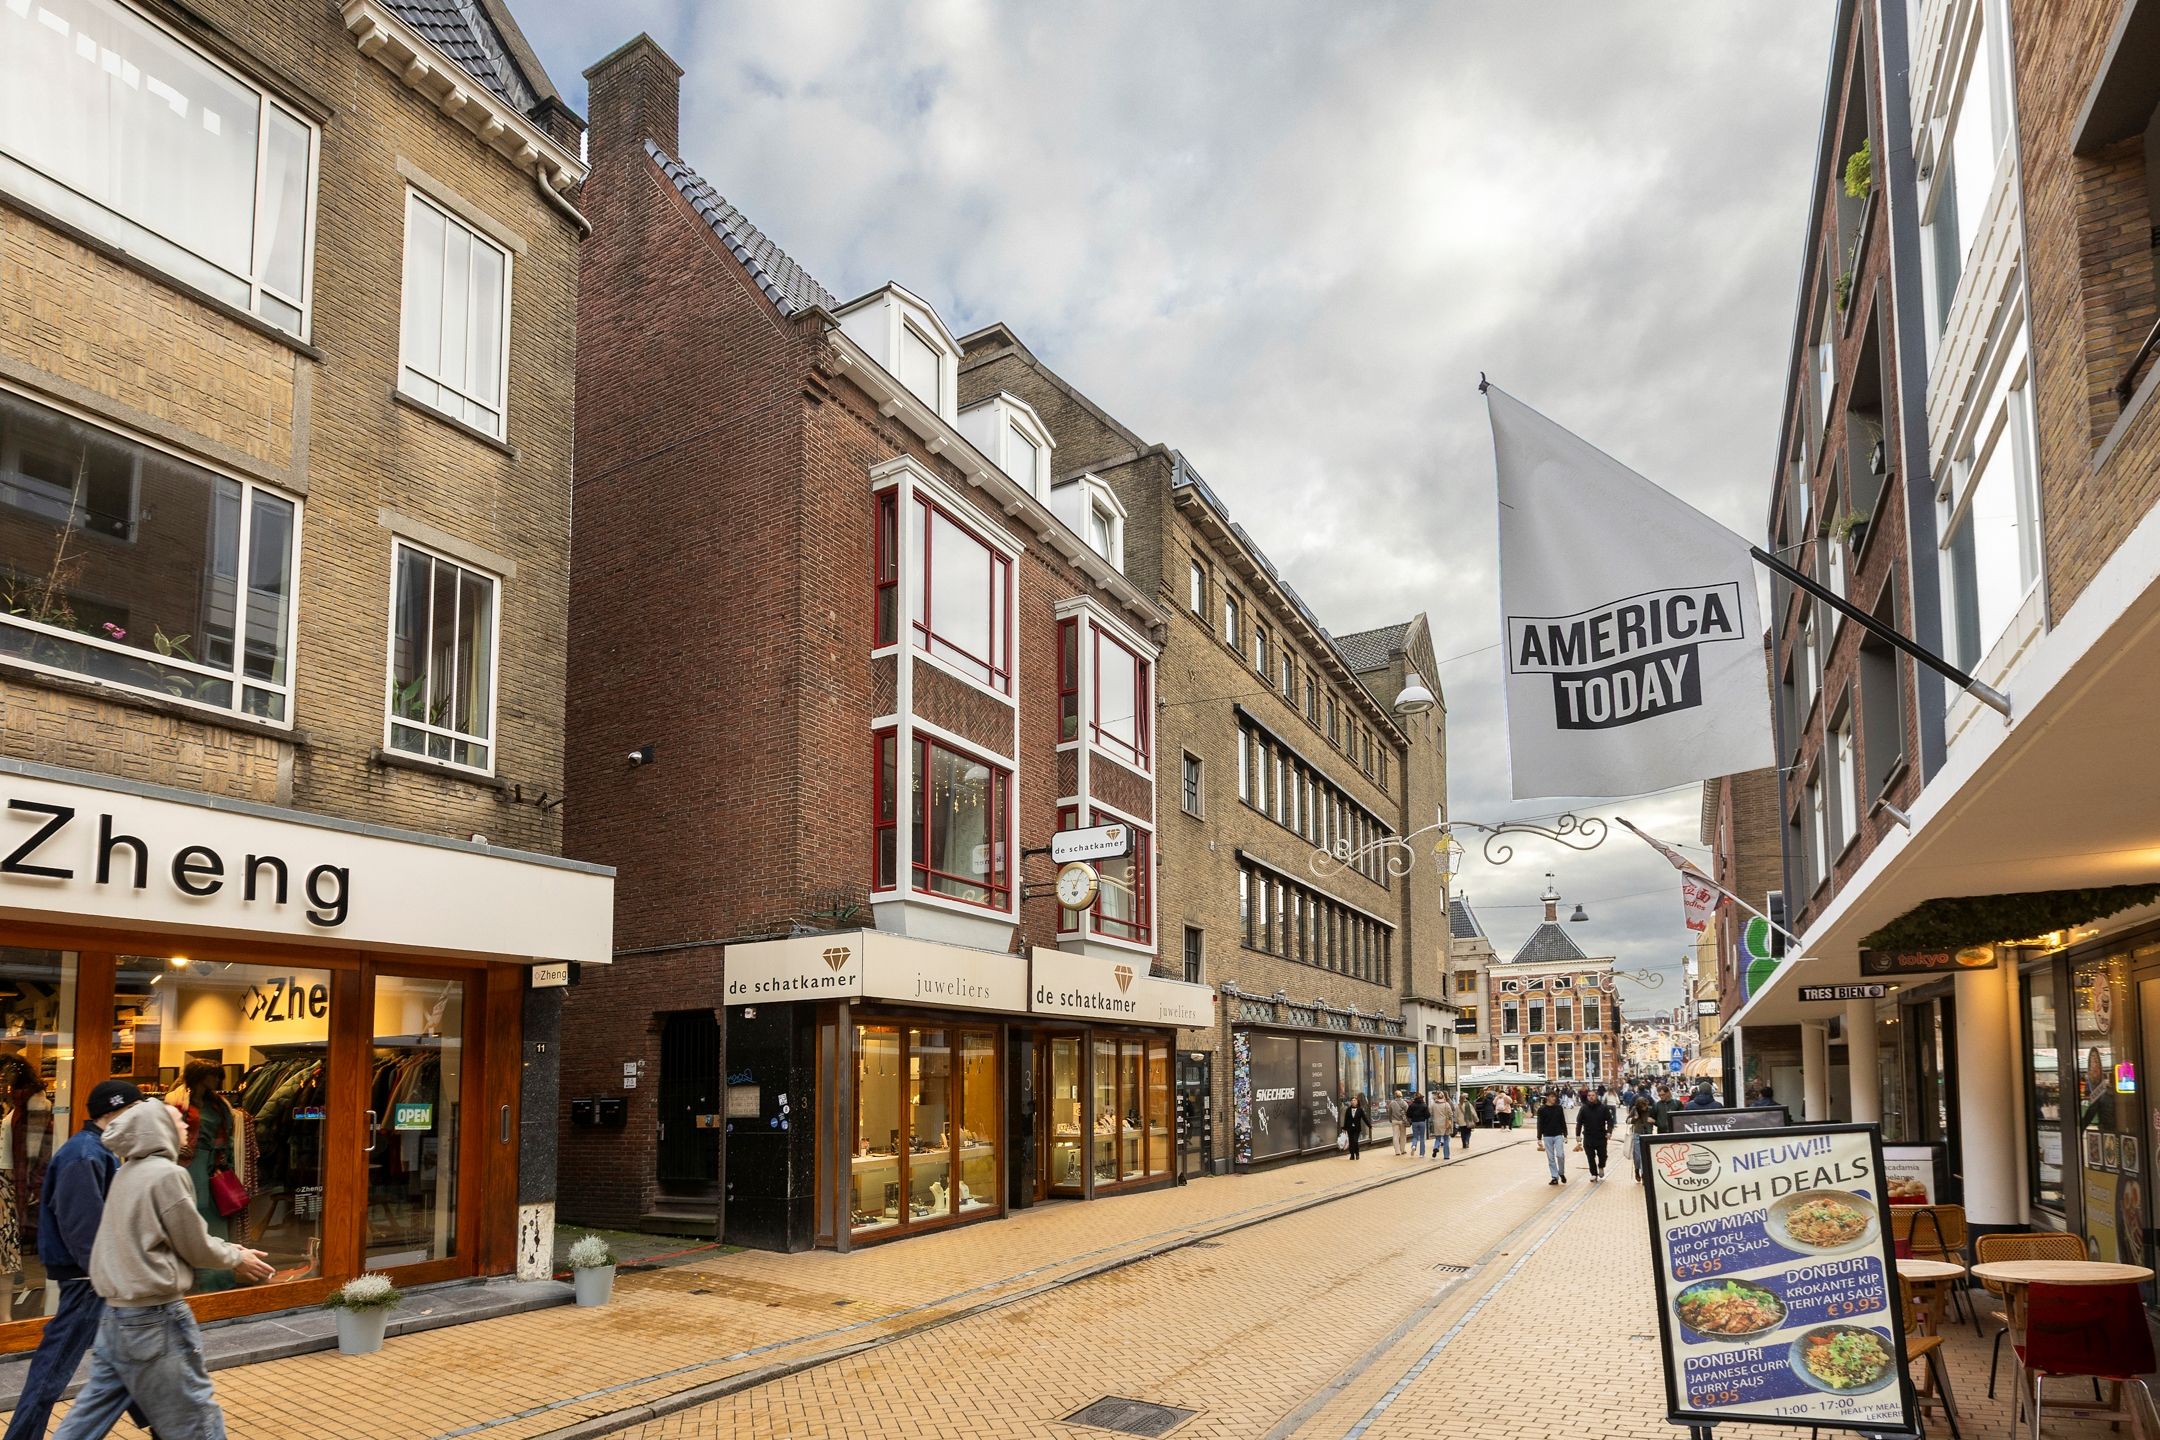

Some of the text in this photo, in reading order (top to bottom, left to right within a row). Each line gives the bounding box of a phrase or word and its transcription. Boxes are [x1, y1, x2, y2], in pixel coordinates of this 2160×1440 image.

[1520, 592, 1733, 666] AMERICA
[1560, 654, 1689, 723] TODAY
[1055, 840, 1124, 855] de schatkamer
[0, 799, 350, 927] Zheng
[1898, 952, 1950, 967] tokyo
[541, 970, 567, 981] Zheng
[729, 975, 856, 995] de schatkamer
[915, 972, 990, 998] juweliers
[1036, 985, 1136, 1013] de schatkamer
[1804, 987, 1865, 1000] TRES BIEN
[1158, 1002, 1196, 1020] juweliers
[536, 1043, 545, 1053] 11
[1024, 1070, 1032, 1091] 3
[801, 1096, 808, 1109] 3
[1256, 1087, 1296, 1102] SKECHERS
[397, 1108, 430, 1123] OPEN
[1732, 1135, 1832, 1173] NIEUW!!!
[1884, 1163, 1920, 1171] cadamia
[1664, 1156, 1869, 1220] LUNCH DEALS
[1674, 1176, 1709, 1187] Tokyo
[1667, 1209, 1767, 1241] CHOW MIAN
[1673, 1231, 1743, 1255] KIP OF TOFU
[1675, 1237, 1770, 1267] KUNG PAO SAUS
[1786, 1257, 1869, 1284] DONBURI
[1786, 1273, 1879, 1298] KROKANTE KIP
[1788, 1286, 1882, 1310] TERIYAKI SAUS
[1828, 1297, 1880, 1316] € 9.95
[1687, 1348, 1763, 1370] DONBURI
[1690, 1359, 1791, 1384] JAPANESE CURRY
[1691, 1375, 1764, 1395] CURRY SAUS
[1693, 1396, 1702, 1407] €
[1775, 1404, 1808, 1416] 11:00
[1820, 1398, 1854, 1411] 17:00
[1840, 1402, 1900, 1416] HEALTY MEAL
